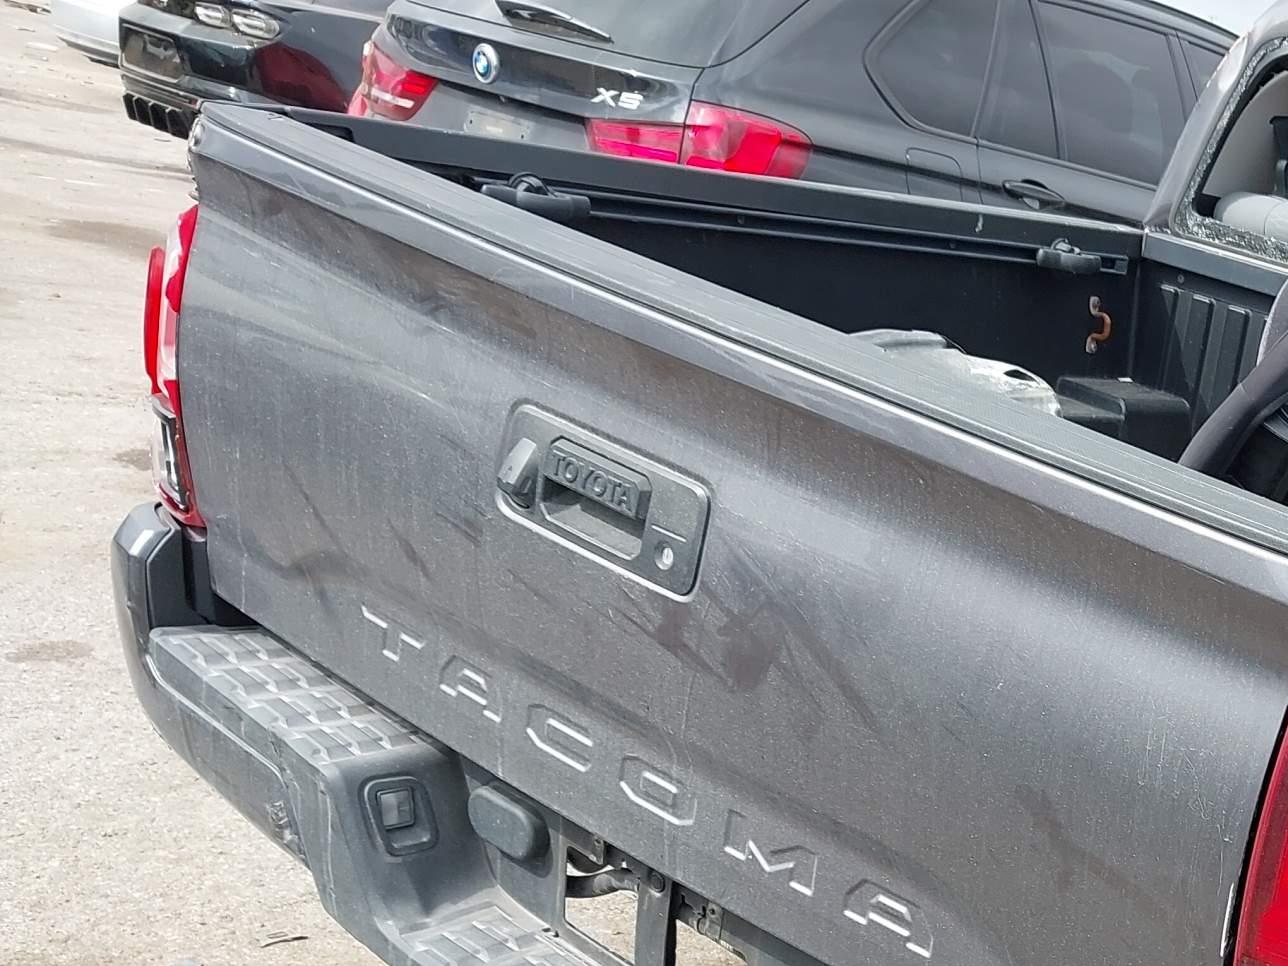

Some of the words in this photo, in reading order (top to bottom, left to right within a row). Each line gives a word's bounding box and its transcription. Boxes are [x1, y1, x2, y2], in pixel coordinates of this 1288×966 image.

[591, 87, 643, 110] X5
[551, 449, 632, 512] TOYOTA
[361, 604, 933, 959] TACOMA
